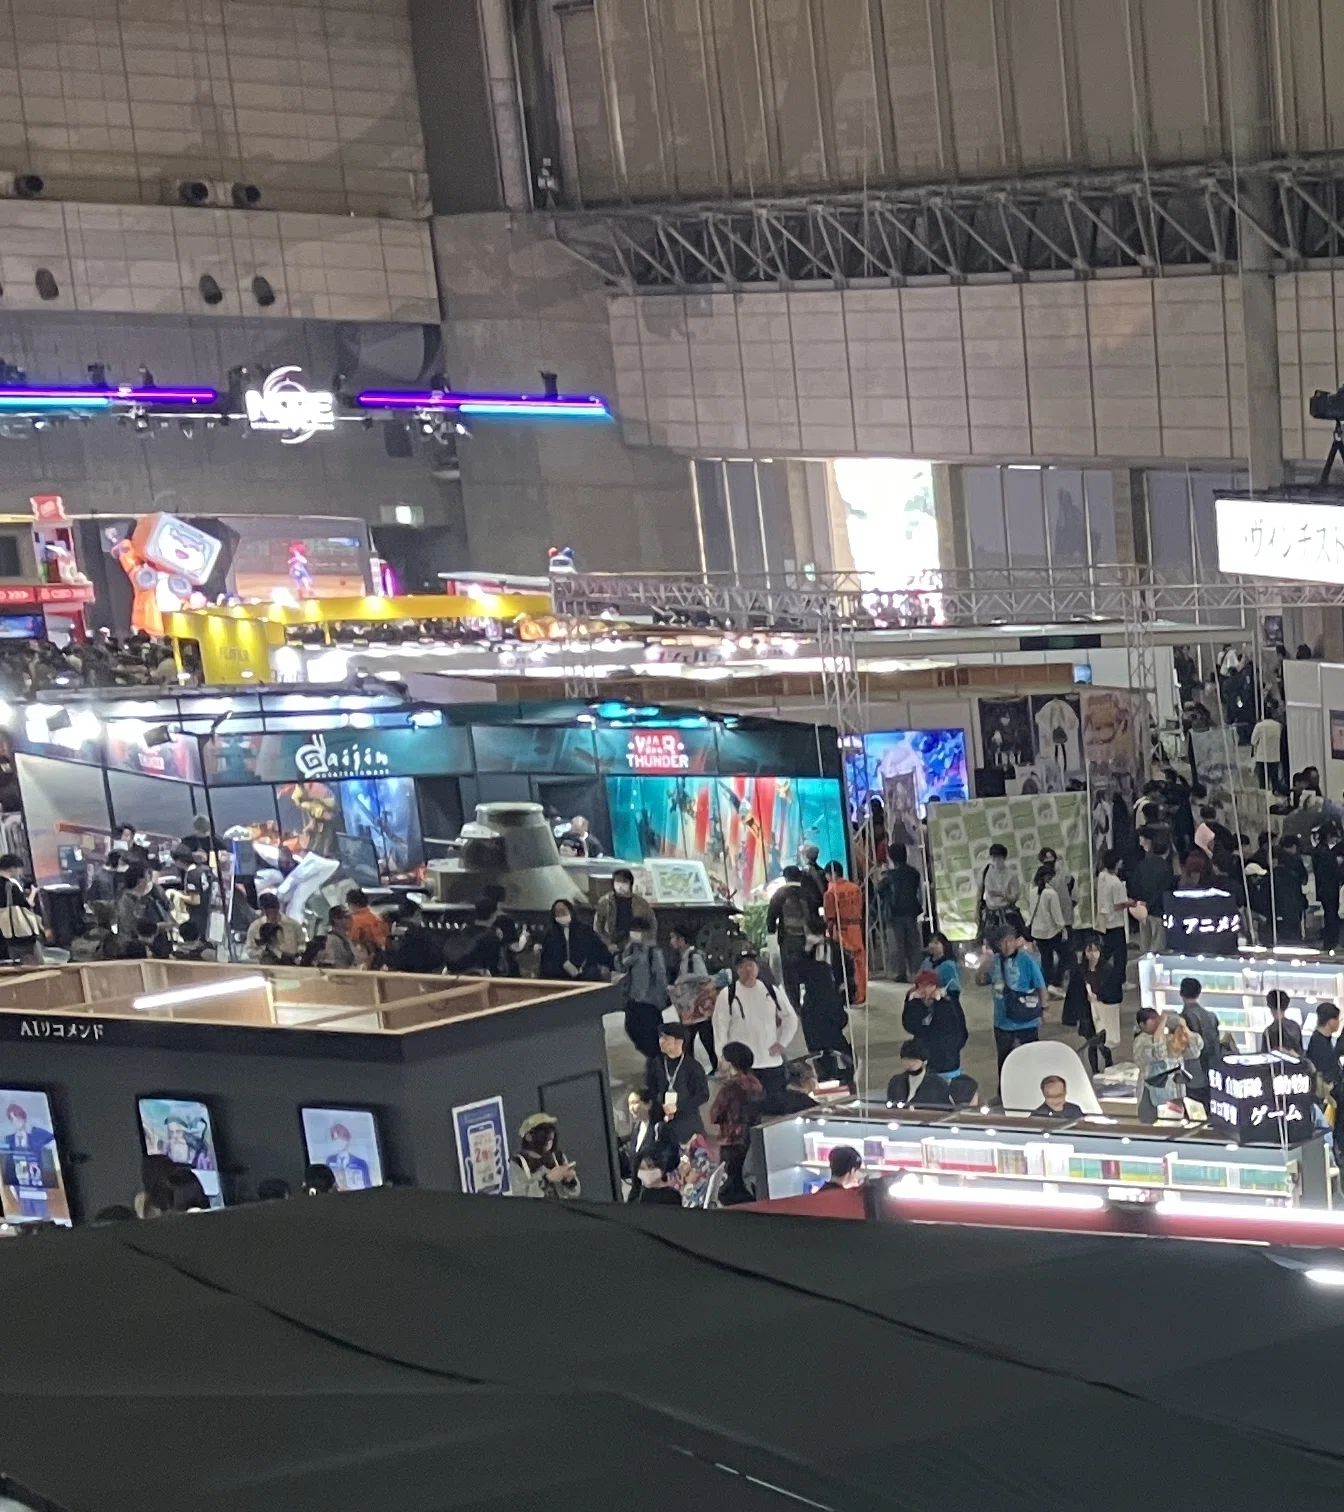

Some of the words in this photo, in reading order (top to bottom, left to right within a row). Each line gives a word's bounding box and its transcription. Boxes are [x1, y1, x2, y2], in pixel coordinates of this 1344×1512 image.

[633, 734, 677, 755] WAR
[625, 753, 690, 769] THUNDER
[20, 1020, 104, 1040] AIリコメンド
[1250, 1103, 1303, 1126] ゲーム
